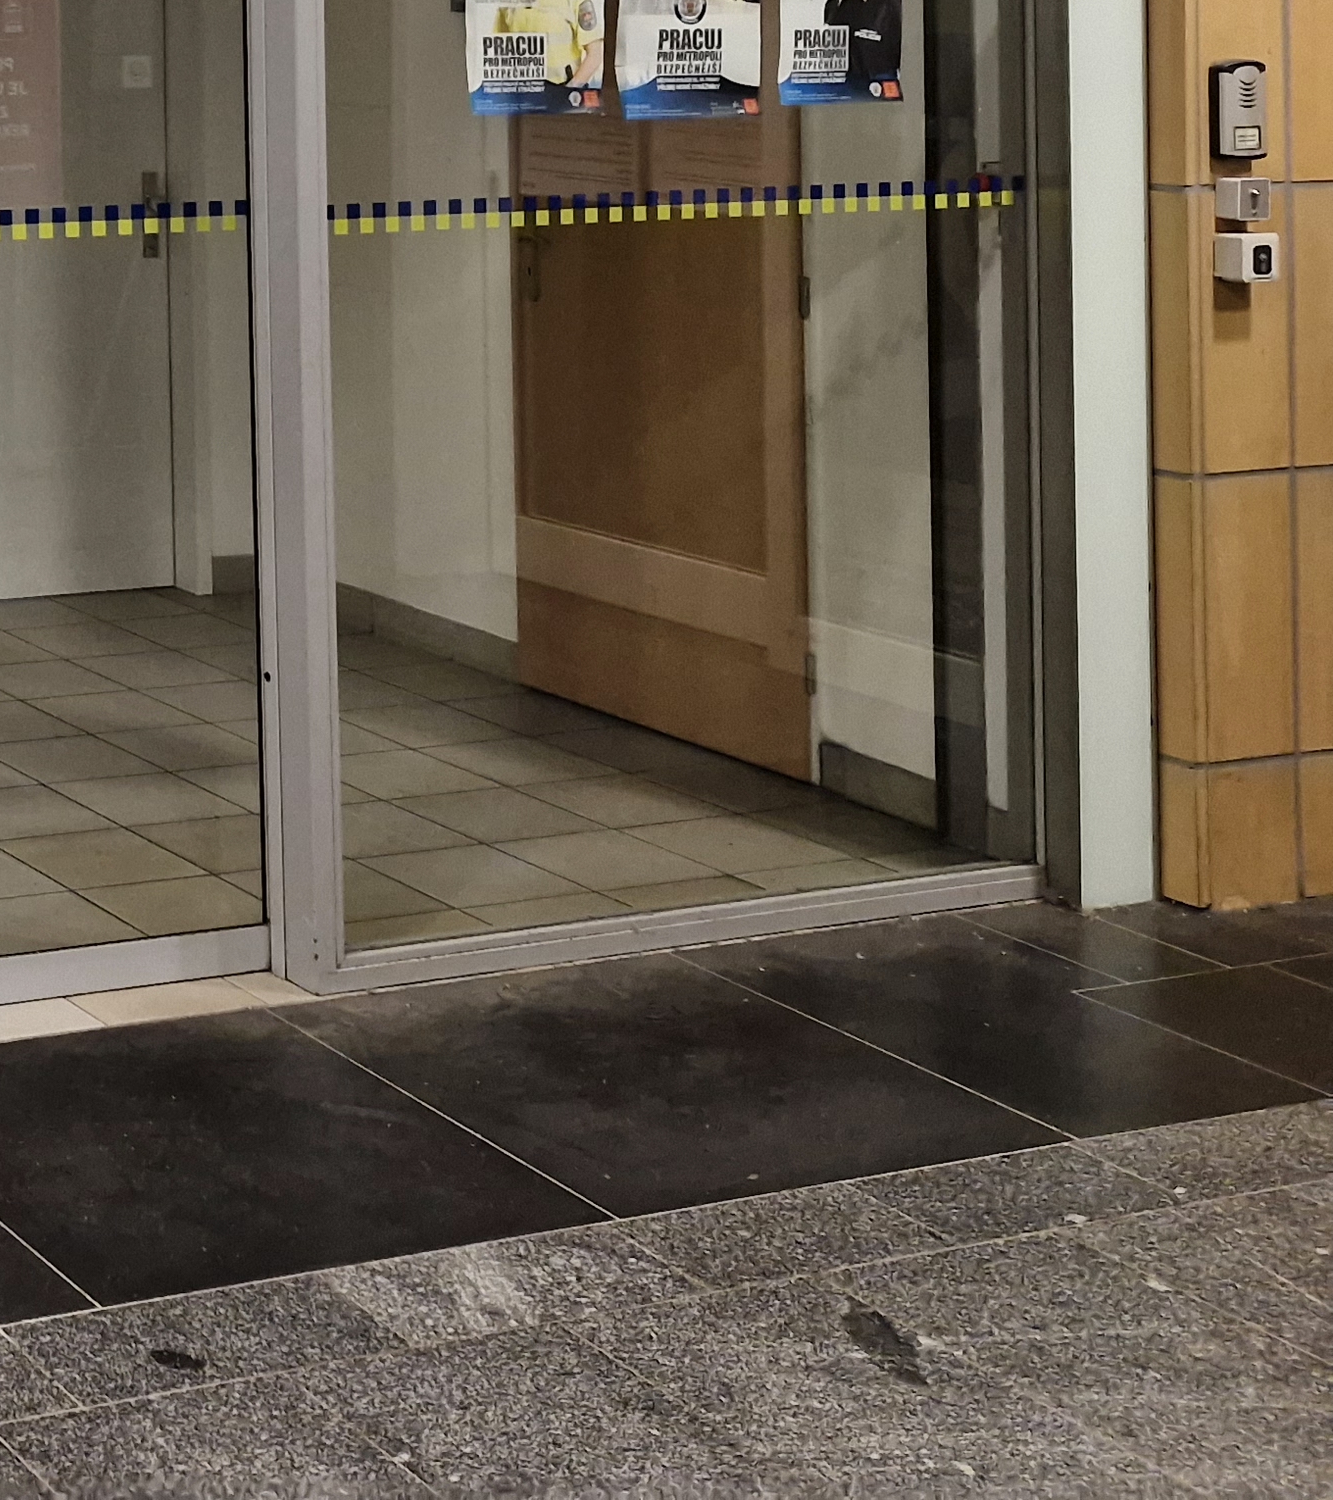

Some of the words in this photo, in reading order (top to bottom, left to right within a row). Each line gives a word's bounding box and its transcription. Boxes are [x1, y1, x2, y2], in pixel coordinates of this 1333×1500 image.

[483, 36, 545, 56] PRACUJ
[658, 28, 722, 50] PRACUJ
[794, 29, 847, 49] PRACUJ
[483, 57, 499, 67] PRO
[501, 57, 545, 67] METROPOLI
[657, 52, 673, 62] PRO
[676, 51, 722, 62] METROPOLI
